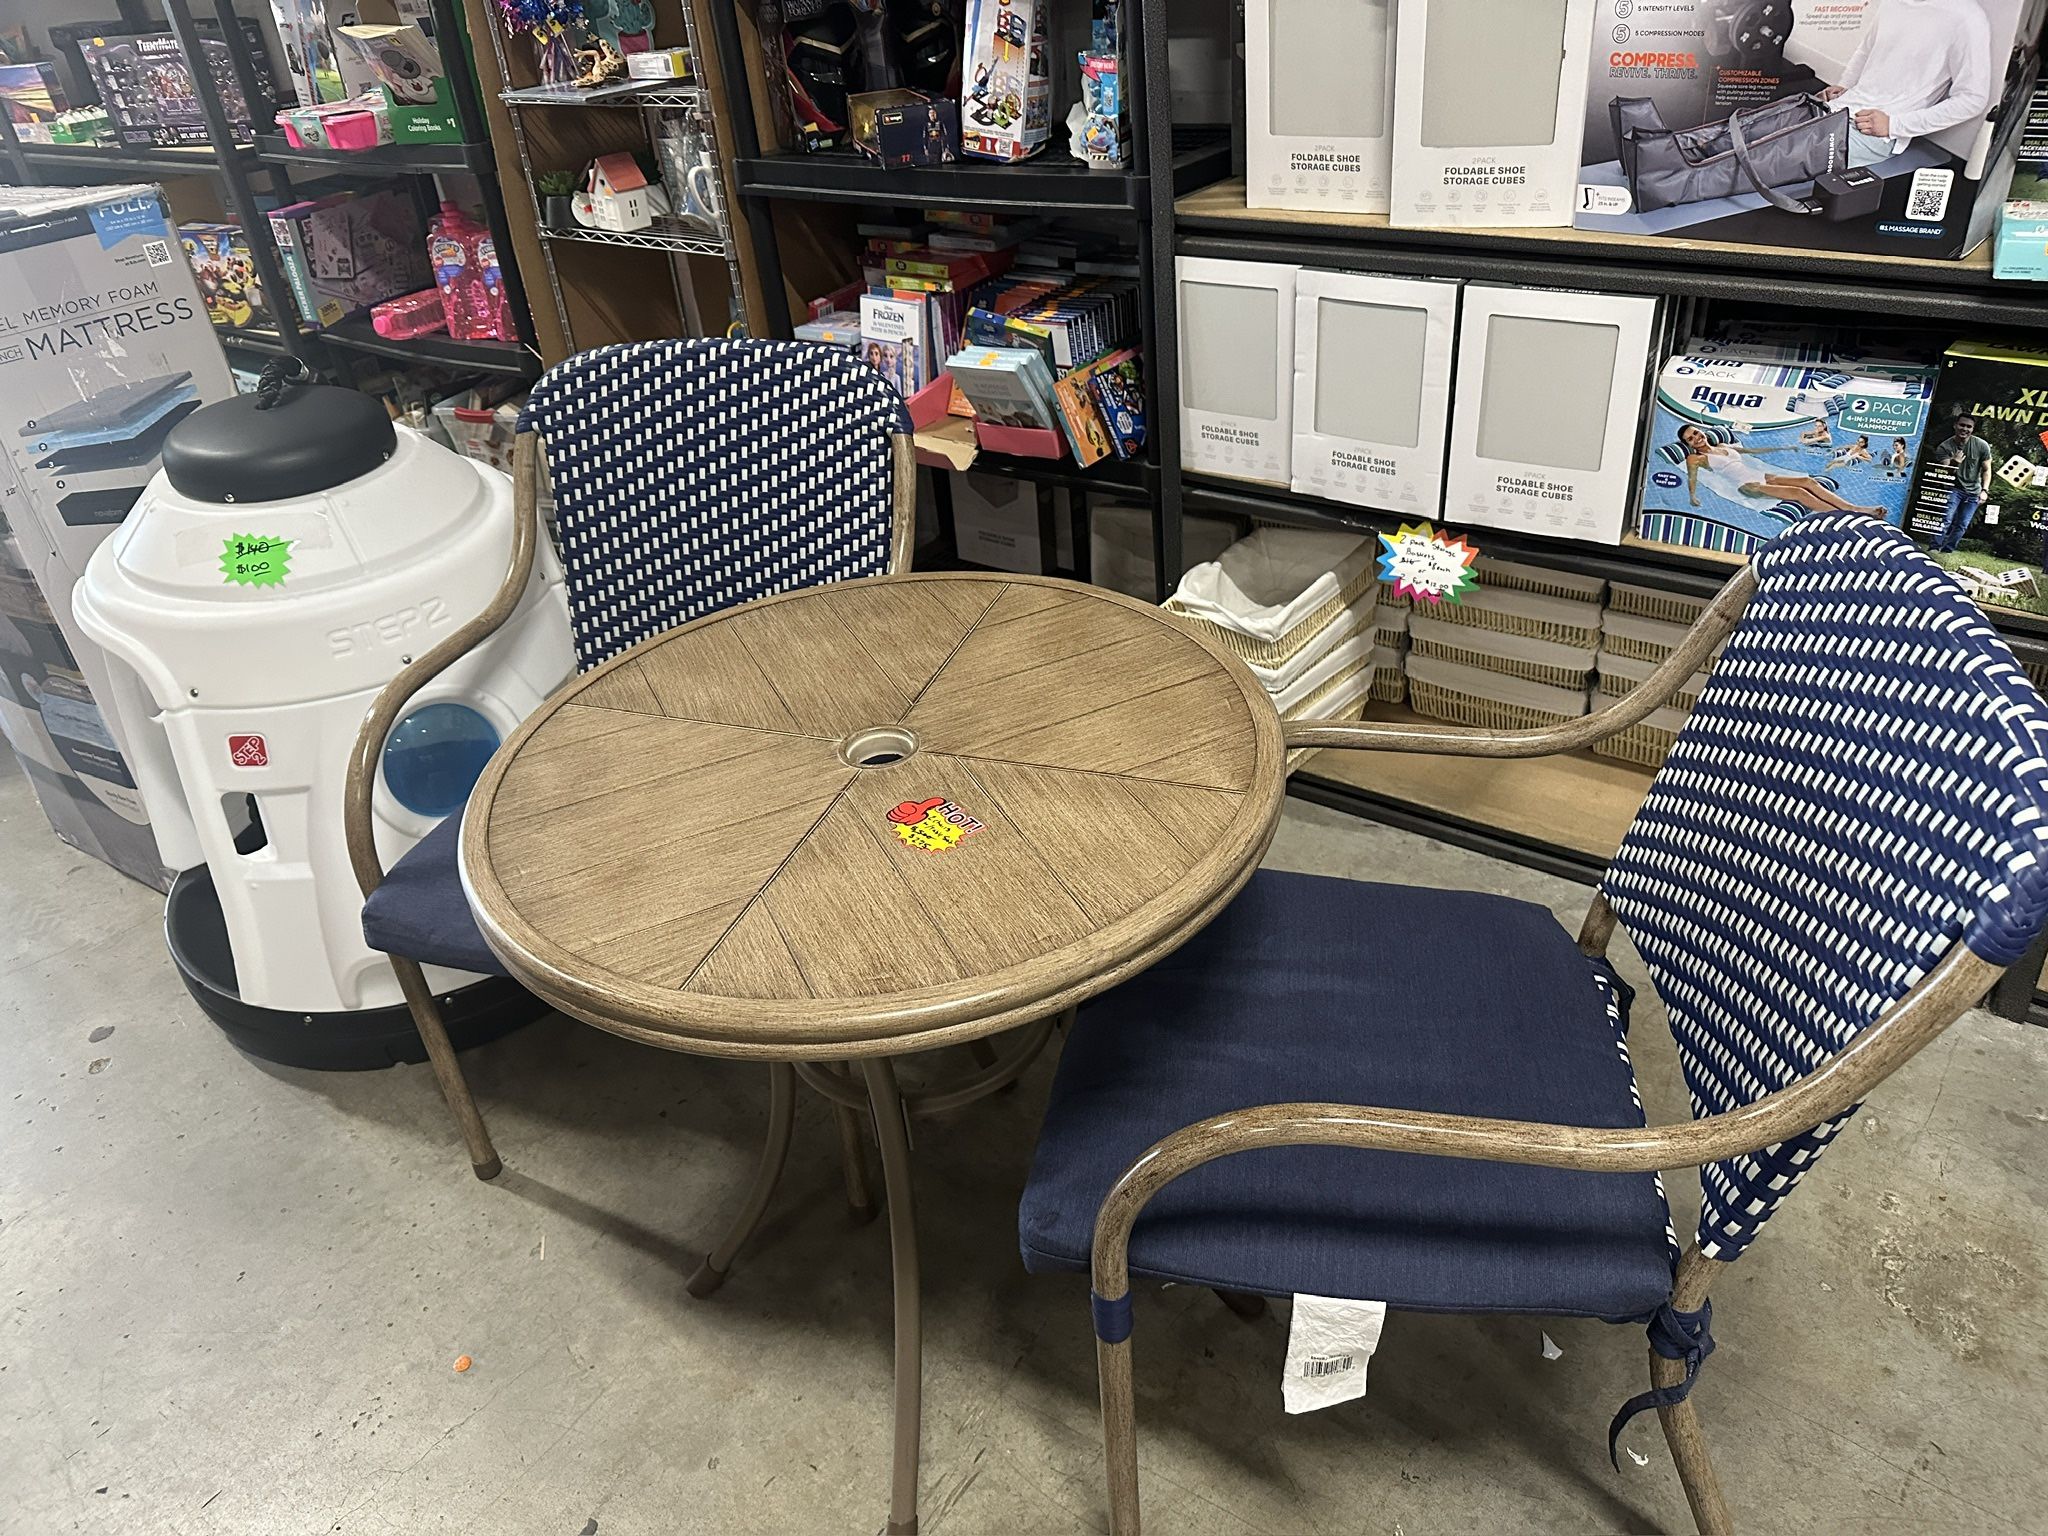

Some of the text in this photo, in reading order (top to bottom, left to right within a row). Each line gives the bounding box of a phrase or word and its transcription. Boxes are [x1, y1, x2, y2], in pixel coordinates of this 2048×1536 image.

[137, 38, 179, 52] TEENYMATE
[1609, 67, 1698, 79] REVIVE. THRIVE.
[408, 124, 427, 132] Coloring
[1291, 153, 1360, 163] FOLDABLE SHOE
[1825, 131, 1835, 174] POWERBOOS
[1290, 162, 1361, 172] STORAGE CUBES
[1444, 166, 1526, 175] FOLDABLE SHOE
[1443, 177, 1526, 185] STORAGE CUBES
[22, 295, 100, 326] MEMORY
[107, 281, 158, 304] FOAM
[873, 308, 905, 323] FROZEN
[24, 297, 193, 361] MATTRESS
[1696, 369, 1737, 379] PACK
[1691, 385, 1764, 411] Aqua
[1856, 400, 1913, 416] 2 PACK
[1970, 403, 2034, 424] LAWN
[1857, 423, 1898, 432] HAMMOCK
[1869, 418, 1912, 427] MONTEREY
[1201, 424, 1259, 439] FOLDABLE SHOE
[1201, 432, 1260, 447] STORAGE CUBES
[1332, 450, 1397, 468] FOLDABLE SHOE
[1331, 458, 1397, 476] STORAGE CUBES
[1497, 476, 1574, 493] FOLDABLE SHOE
[1495, 484, 1574, 501] STORAGE CUBES
[1920, 495, 1948, 504] INCLUDED
[2032, 510, 2041, 520] 6
[1400, 535, 1407, 544] 2
[236, 561, 270, 576] $100
[232, 736, 260, 765] STEP
[250, 752, 267, 765] 2
[938, 801, 983, 834] HOT!
